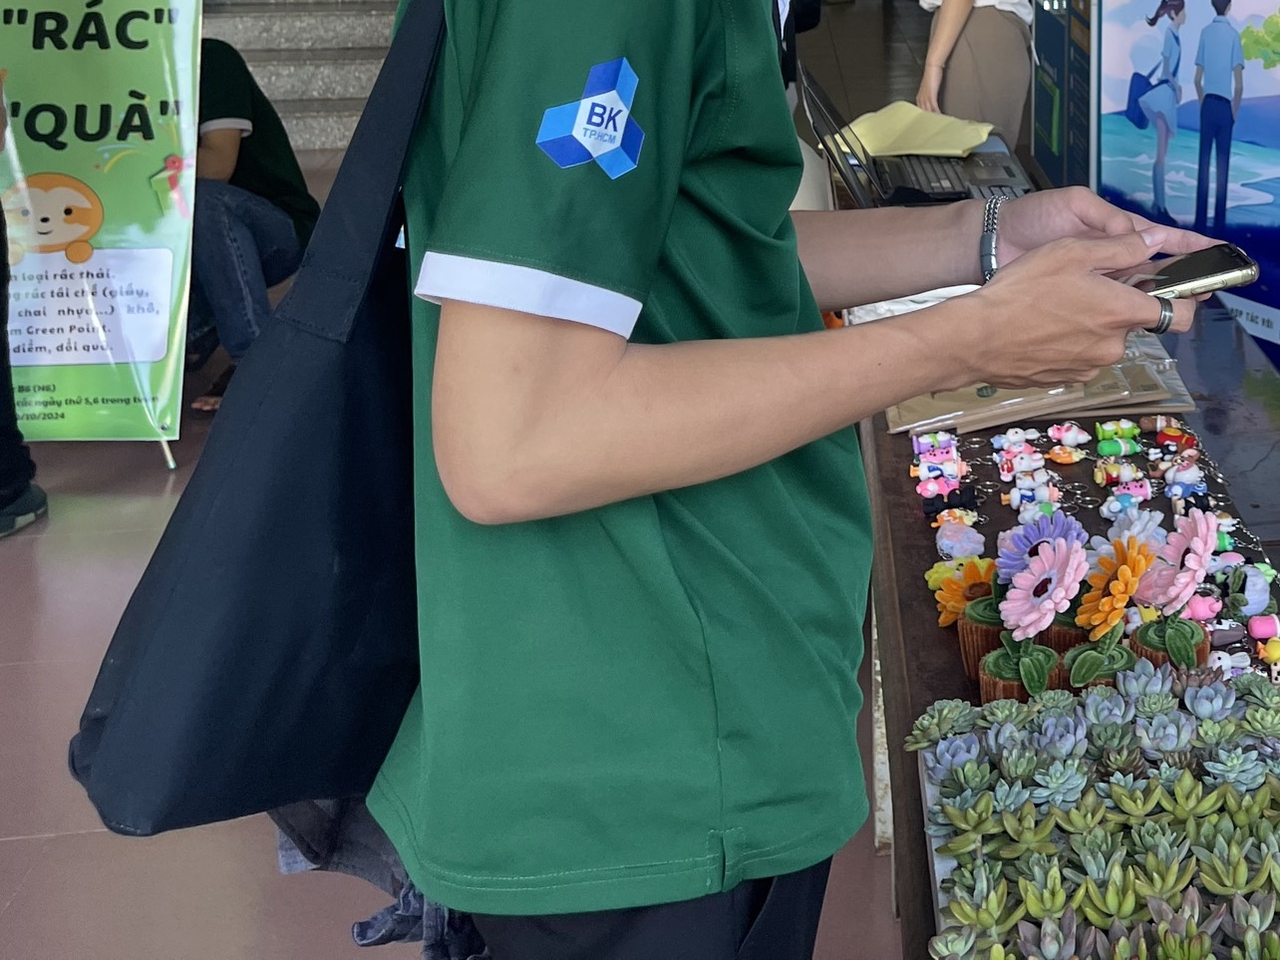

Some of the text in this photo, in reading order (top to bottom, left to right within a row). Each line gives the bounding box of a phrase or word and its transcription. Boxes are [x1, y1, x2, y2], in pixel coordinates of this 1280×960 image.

[586, 102, 623, 132] BK
[582, 127, 617, 145] TP.HCM
[18, 306, 47, 317] chai
[26, 325, 65, 336] Green
